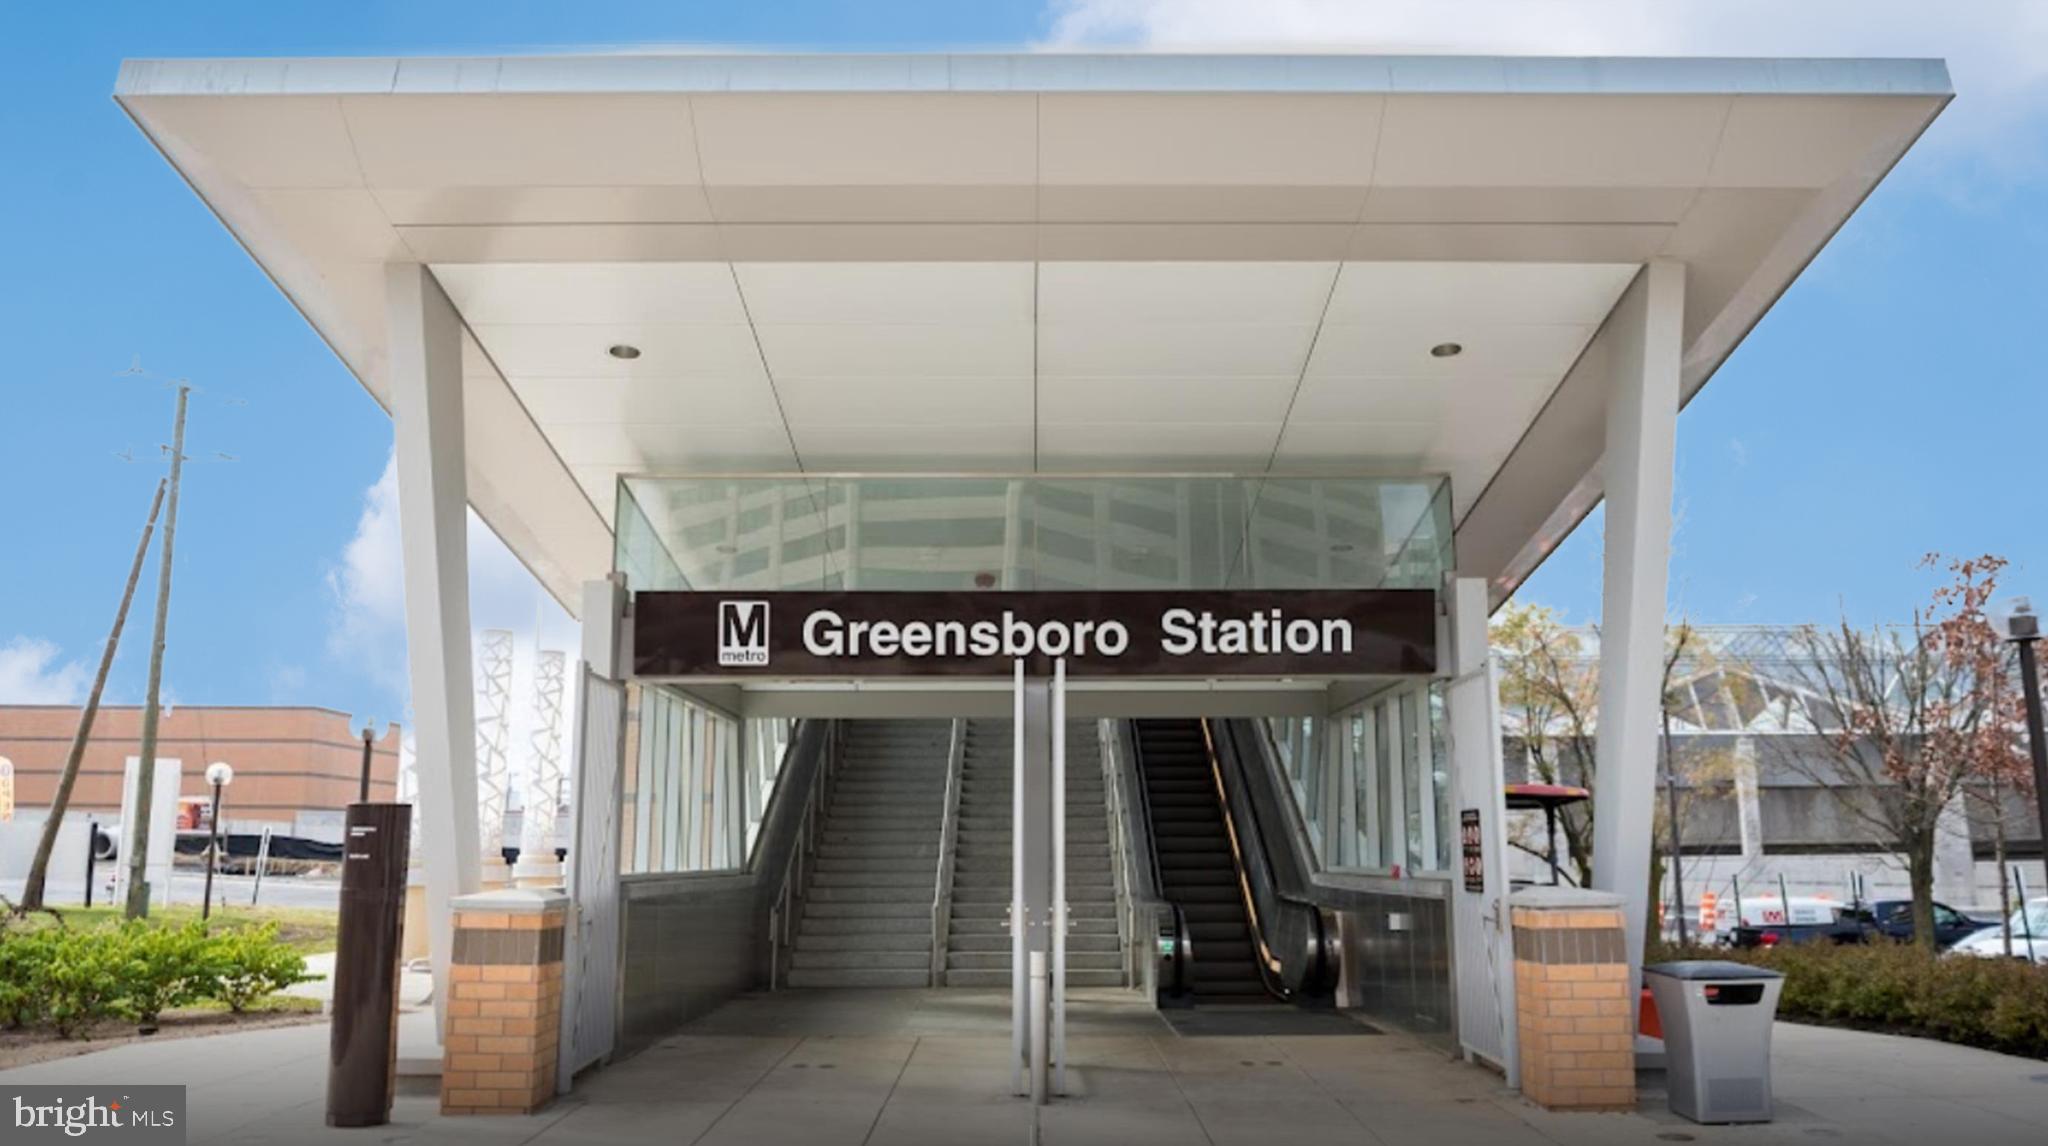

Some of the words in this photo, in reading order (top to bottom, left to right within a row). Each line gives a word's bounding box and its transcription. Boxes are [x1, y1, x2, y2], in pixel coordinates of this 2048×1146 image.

[723, 604, 765, 647] M
[803, 610, 1128, 656] Greensboro
[1161, 608, 1353, 655] Station
[721, 650, 766, 662] metro
